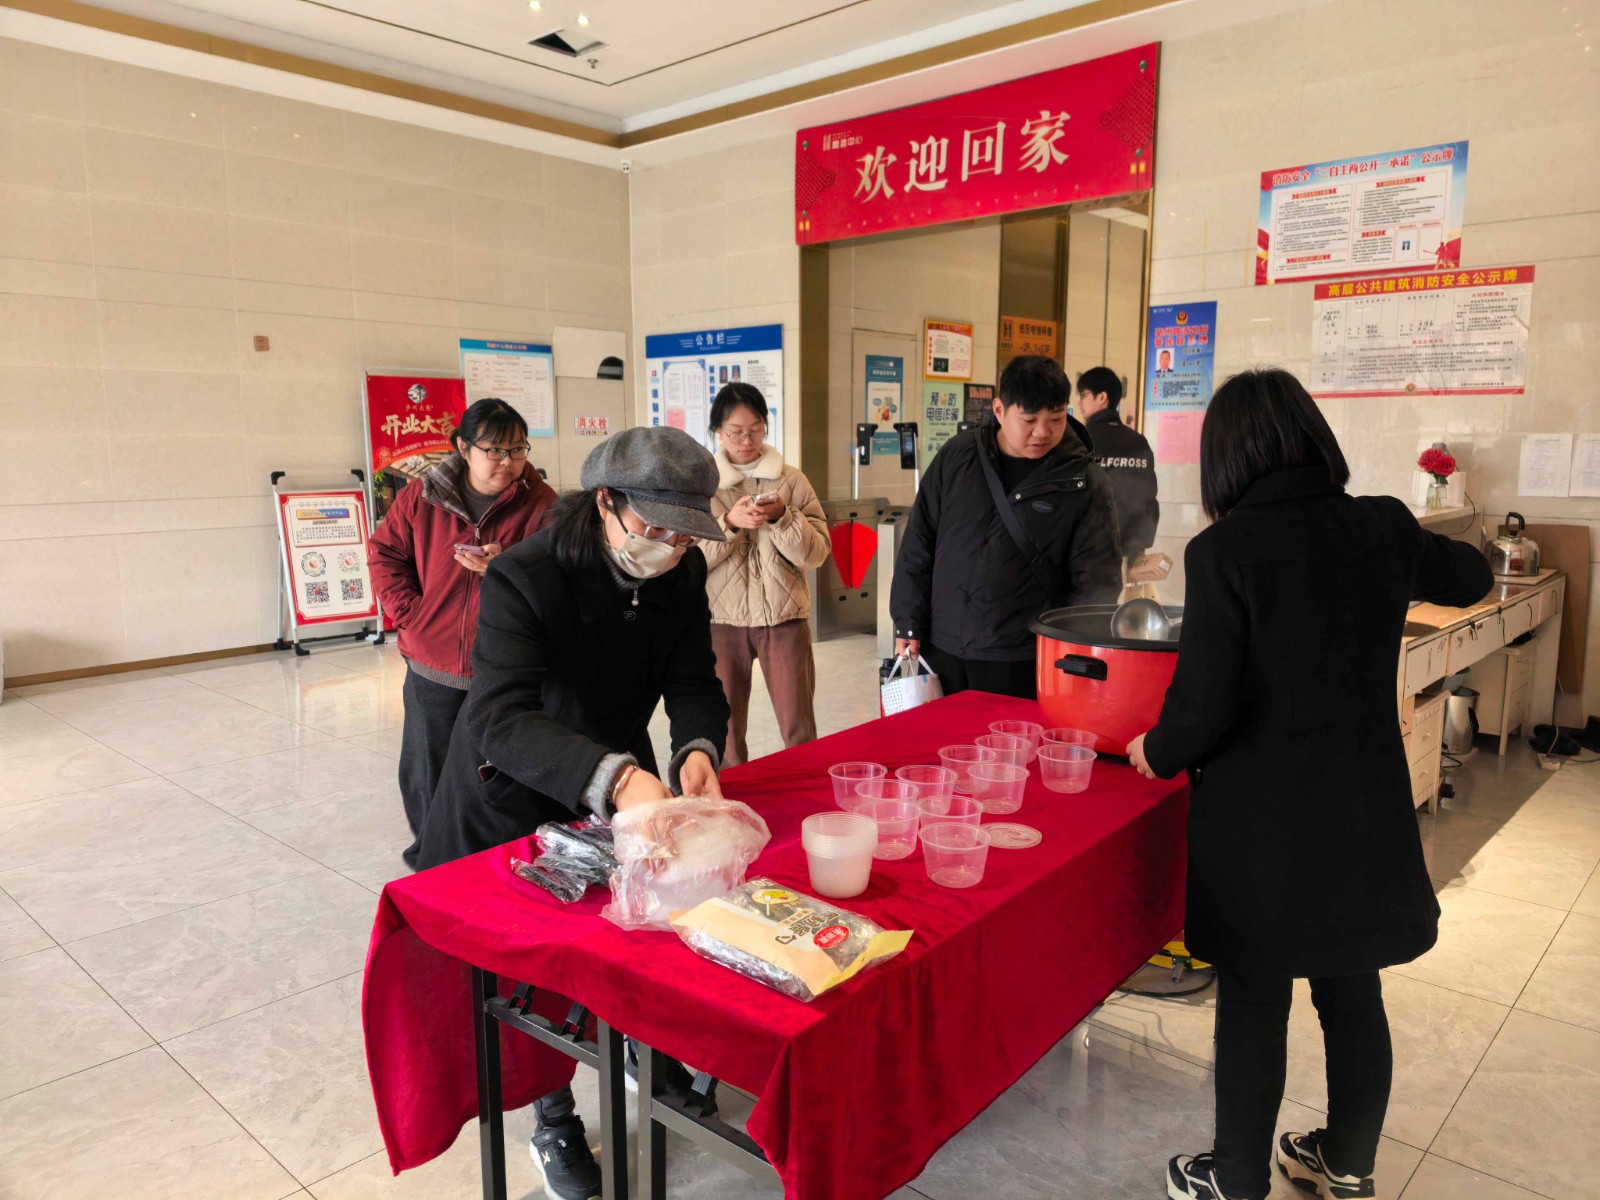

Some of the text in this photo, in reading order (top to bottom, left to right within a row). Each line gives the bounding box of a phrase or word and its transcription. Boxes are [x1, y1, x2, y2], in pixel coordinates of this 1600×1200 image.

[853, 110, 1071, 204] 欢迎回家
[1328, 269, 1518, 296] 高层公共建筑消防安全公示牌
[695, 332, 725, 346] 公告栏
[381, 412, 457, 447] 开业大吉
[577, 416, 607, 429] 消火栓
